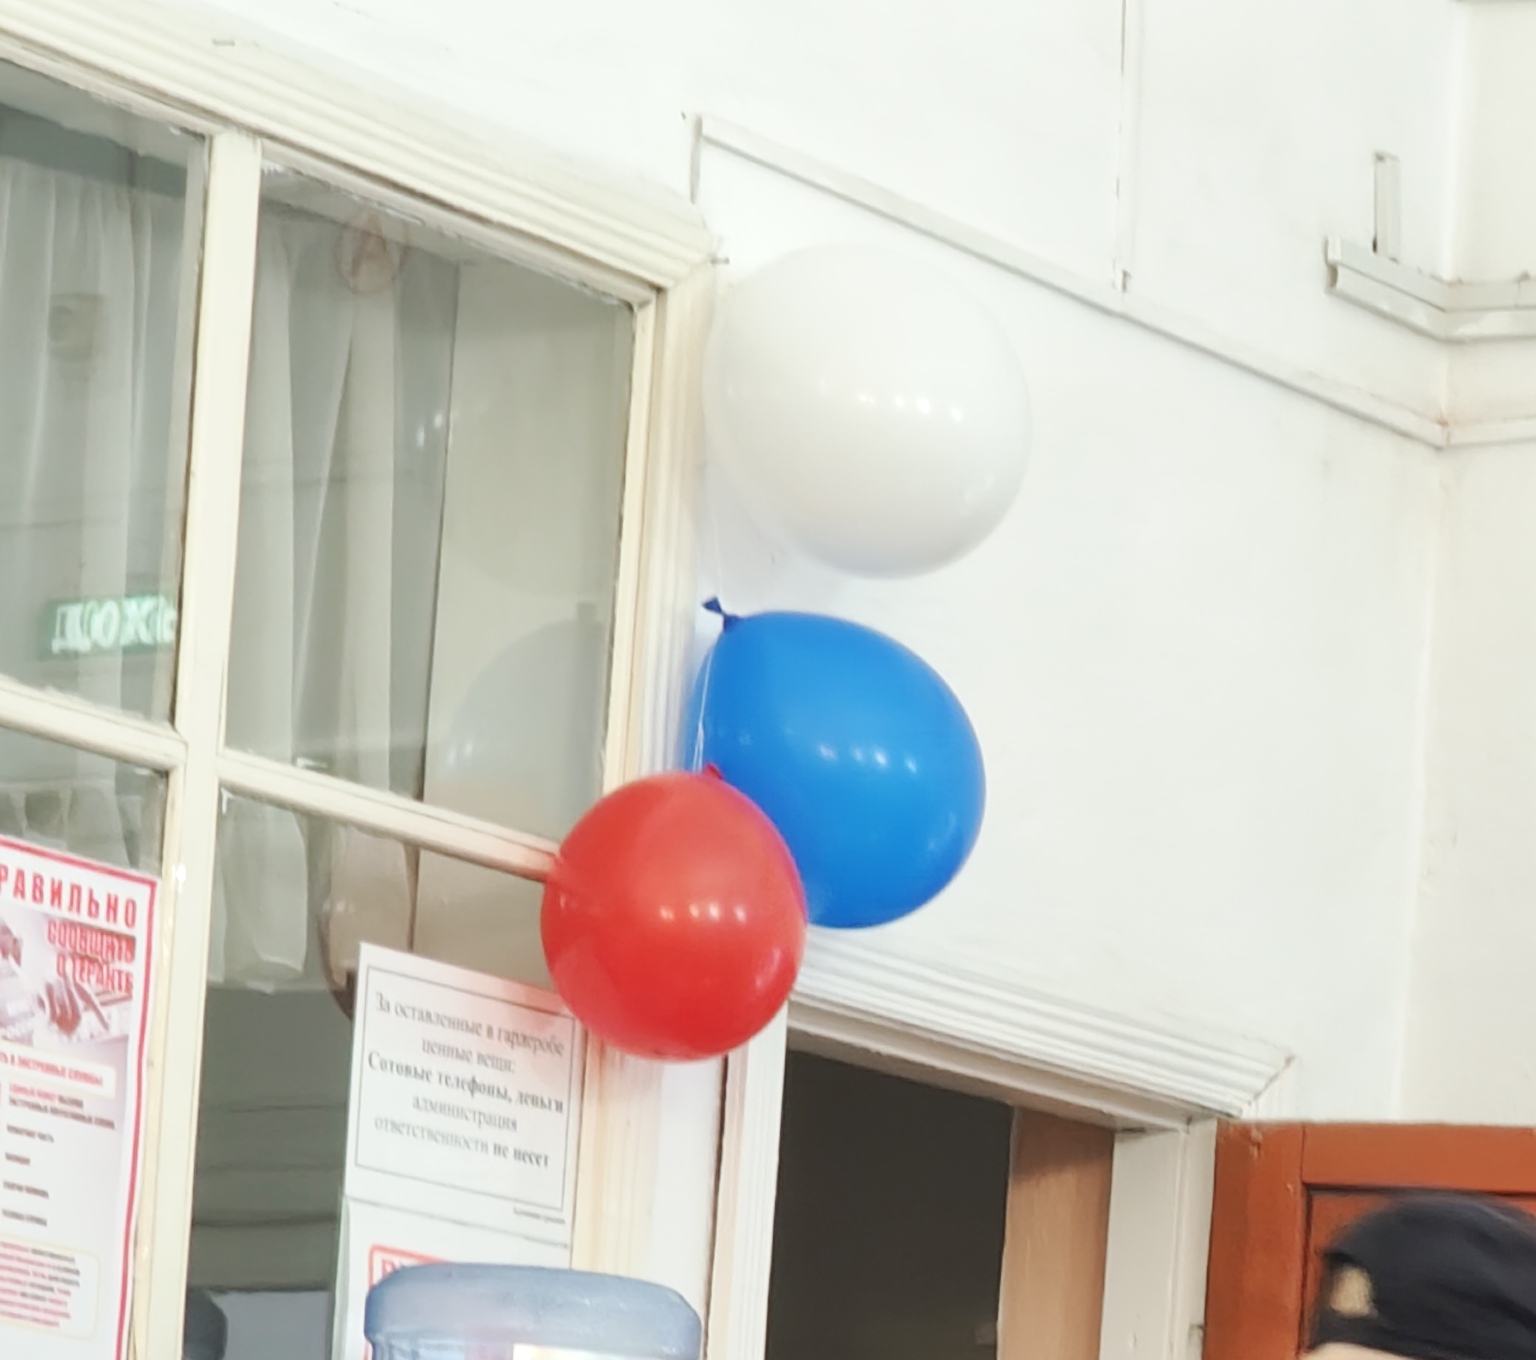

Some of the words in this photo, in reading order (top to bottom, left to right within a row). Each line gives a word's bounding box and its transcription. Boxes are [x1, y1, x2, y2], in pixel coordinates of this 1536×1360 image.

[376, 992, 391, 1012] За
[395, 1001, 482, 1036] оставленные
[486, 1026, 494, 1039] в
[497, 1028, 565, 1057] гардеробе
[422, 1038, 474, 1064] ценные
[368, 1050, 432, 1083] Сотовые
[437, 1071, 512, 1103] телефоны,
[517, 1092, 564, 1114] деньги
[412, 1096, 518, 1132] администрация
[375, 1117, 489, 1155] ответственности
[493, 1142, 509, 1160] не
